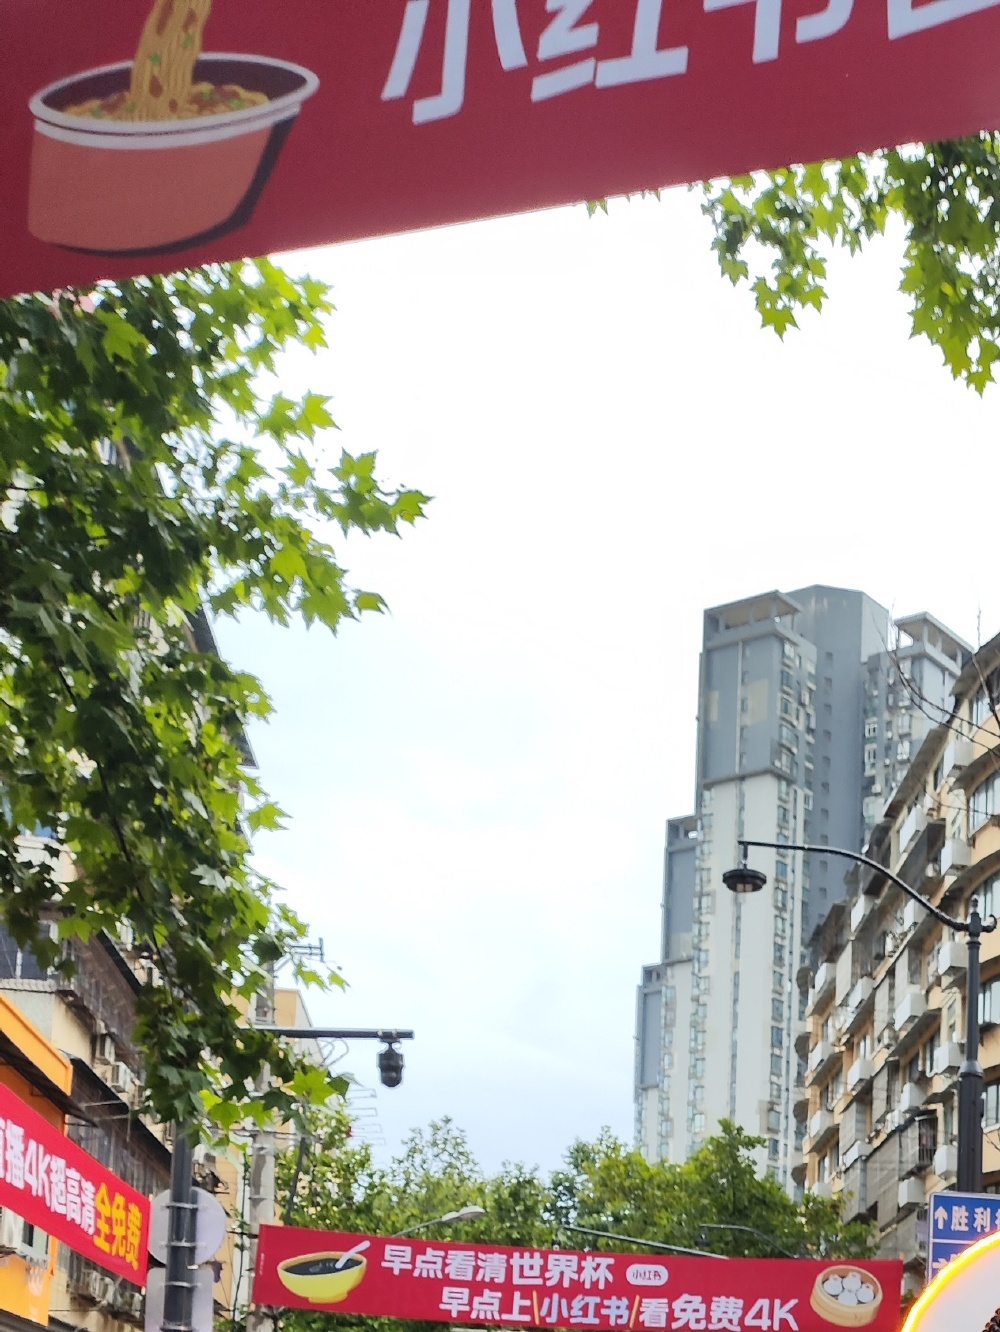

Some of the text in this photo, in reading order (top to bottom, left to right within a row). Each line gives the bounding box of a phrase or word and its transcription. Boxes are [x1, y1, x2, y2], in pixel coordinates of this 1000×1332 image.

[381, 1243, 615, 1290] 早点看清世界杯
[632, 1269, 663, 1281] 小红书
